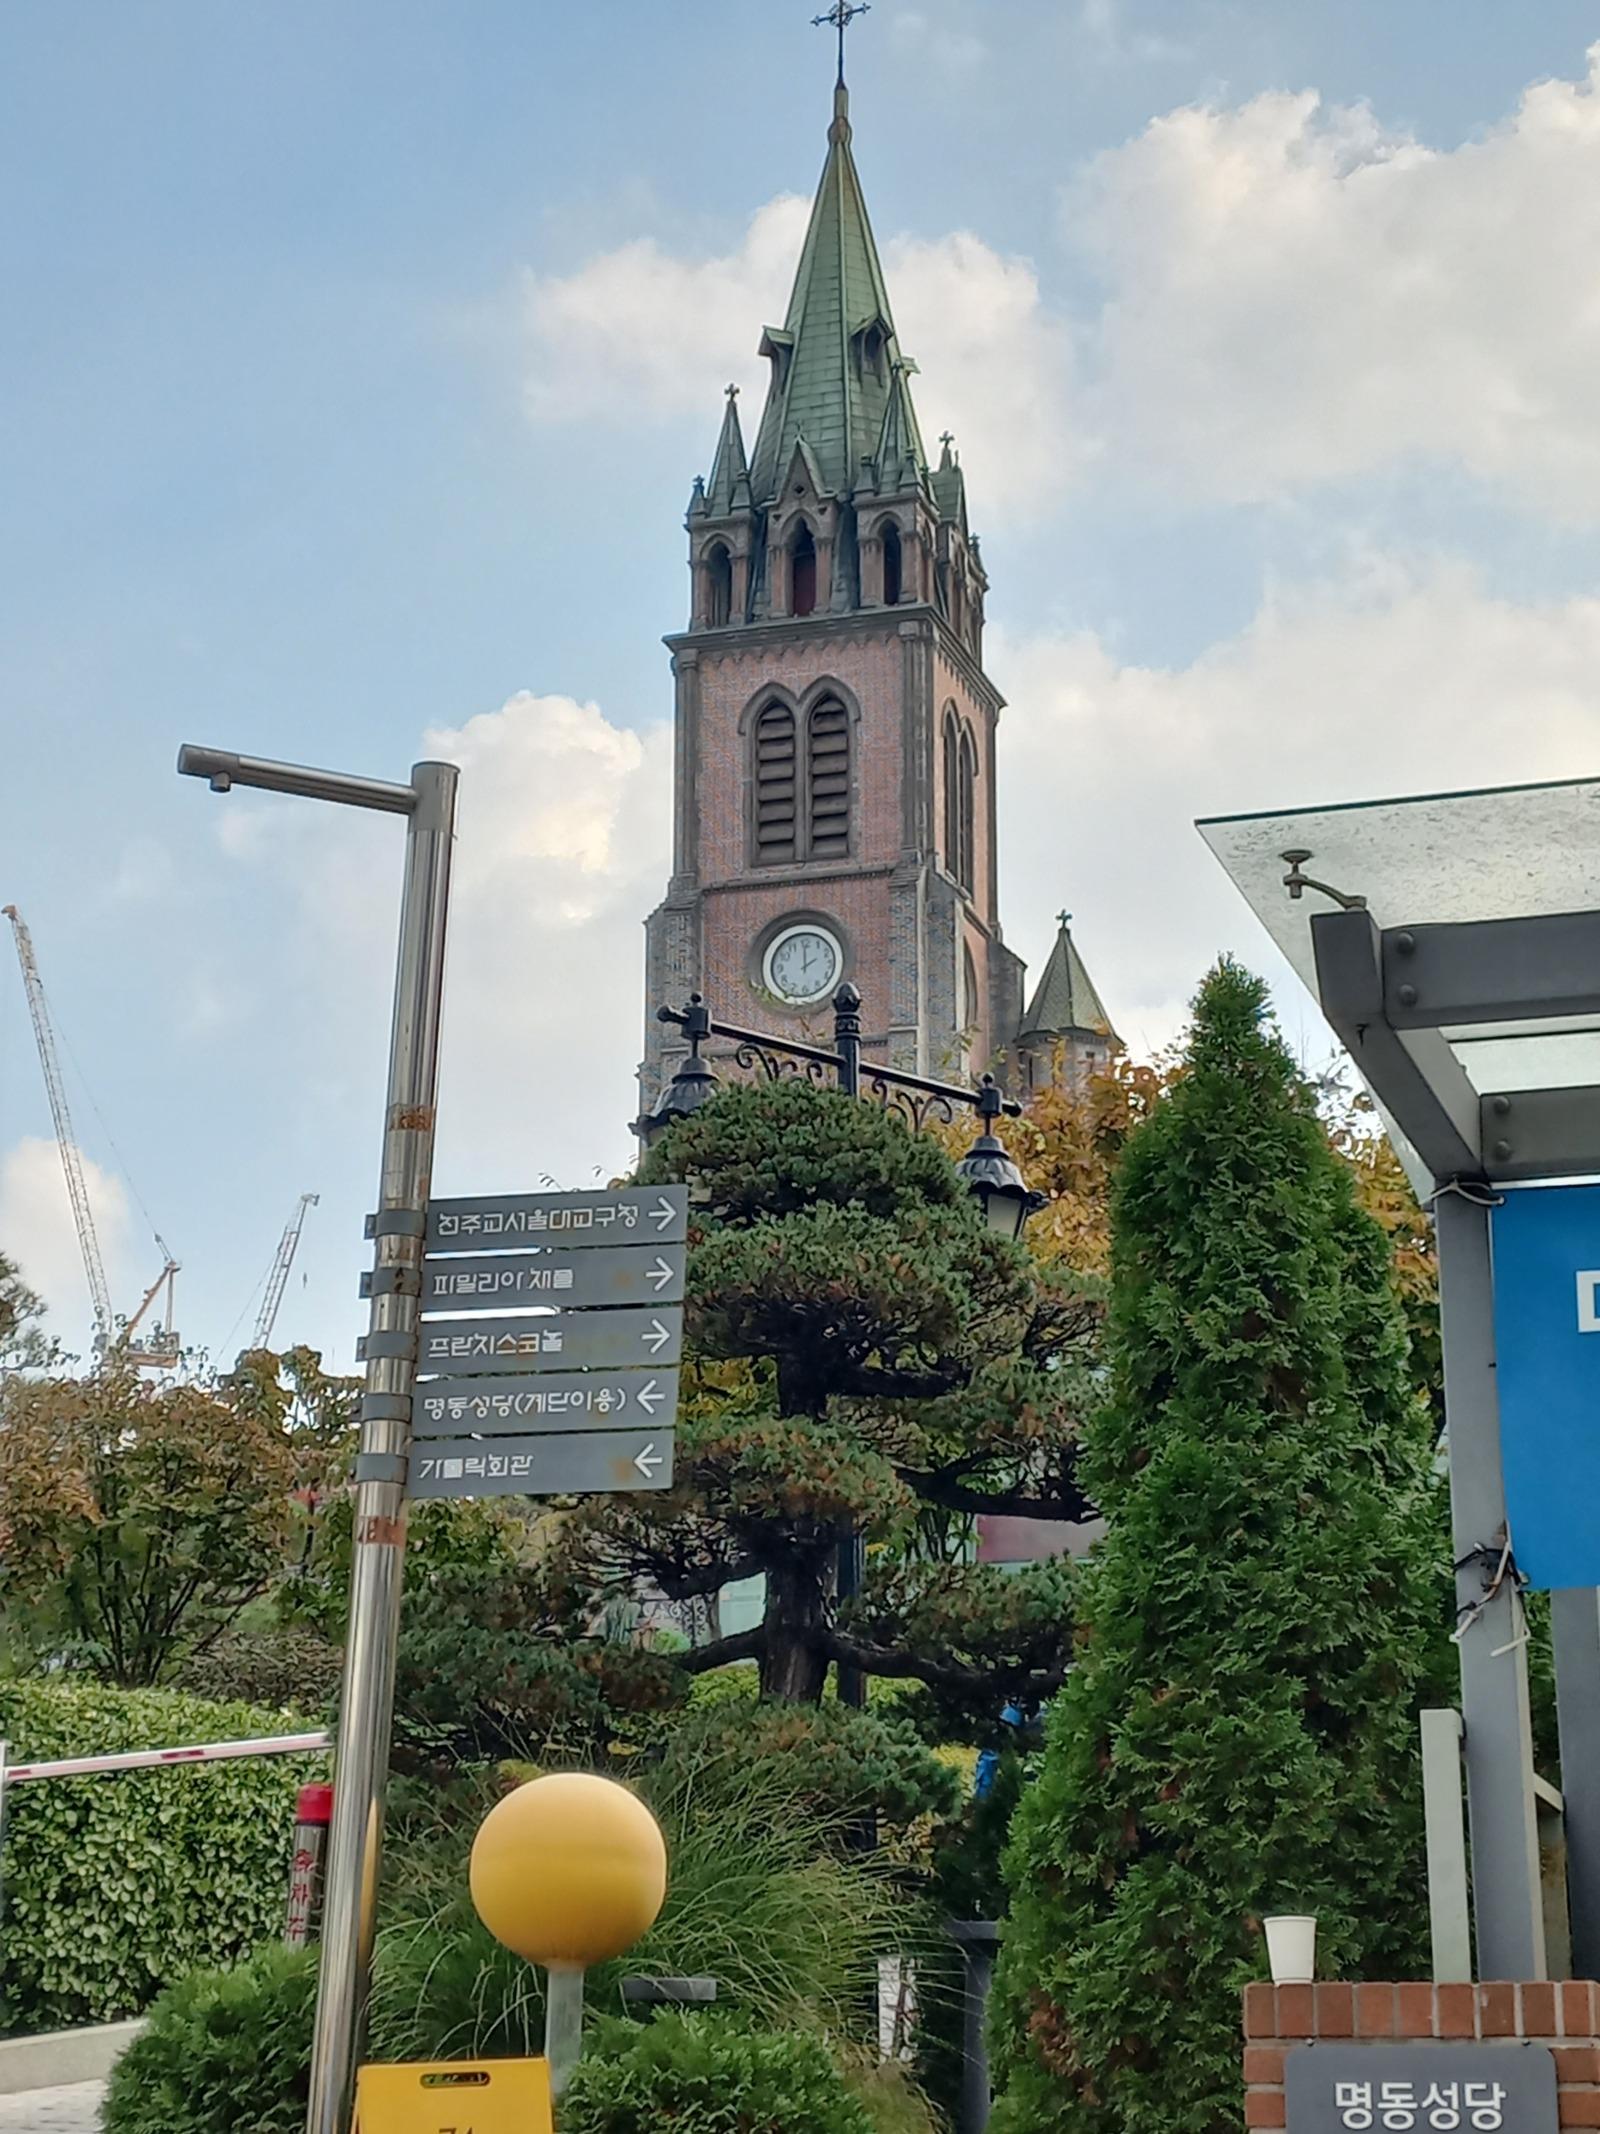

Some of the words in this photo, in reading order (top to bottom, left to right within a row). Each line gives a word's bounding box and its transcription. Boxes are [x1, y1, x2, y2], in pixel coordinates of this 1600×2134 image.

[438, 1202, 639, 1236] 천주교서울대교구청
[433, 1270, 524, 1295] 파밀리아
[528, 1267, 573, 1290] 채플
[428, 1329, 563, 1357] 프란치스코홀
[424, 1387, 626, 1421] 명동성당(계단이용)
[1335, 2081, 1507, 2131] 명동성당
